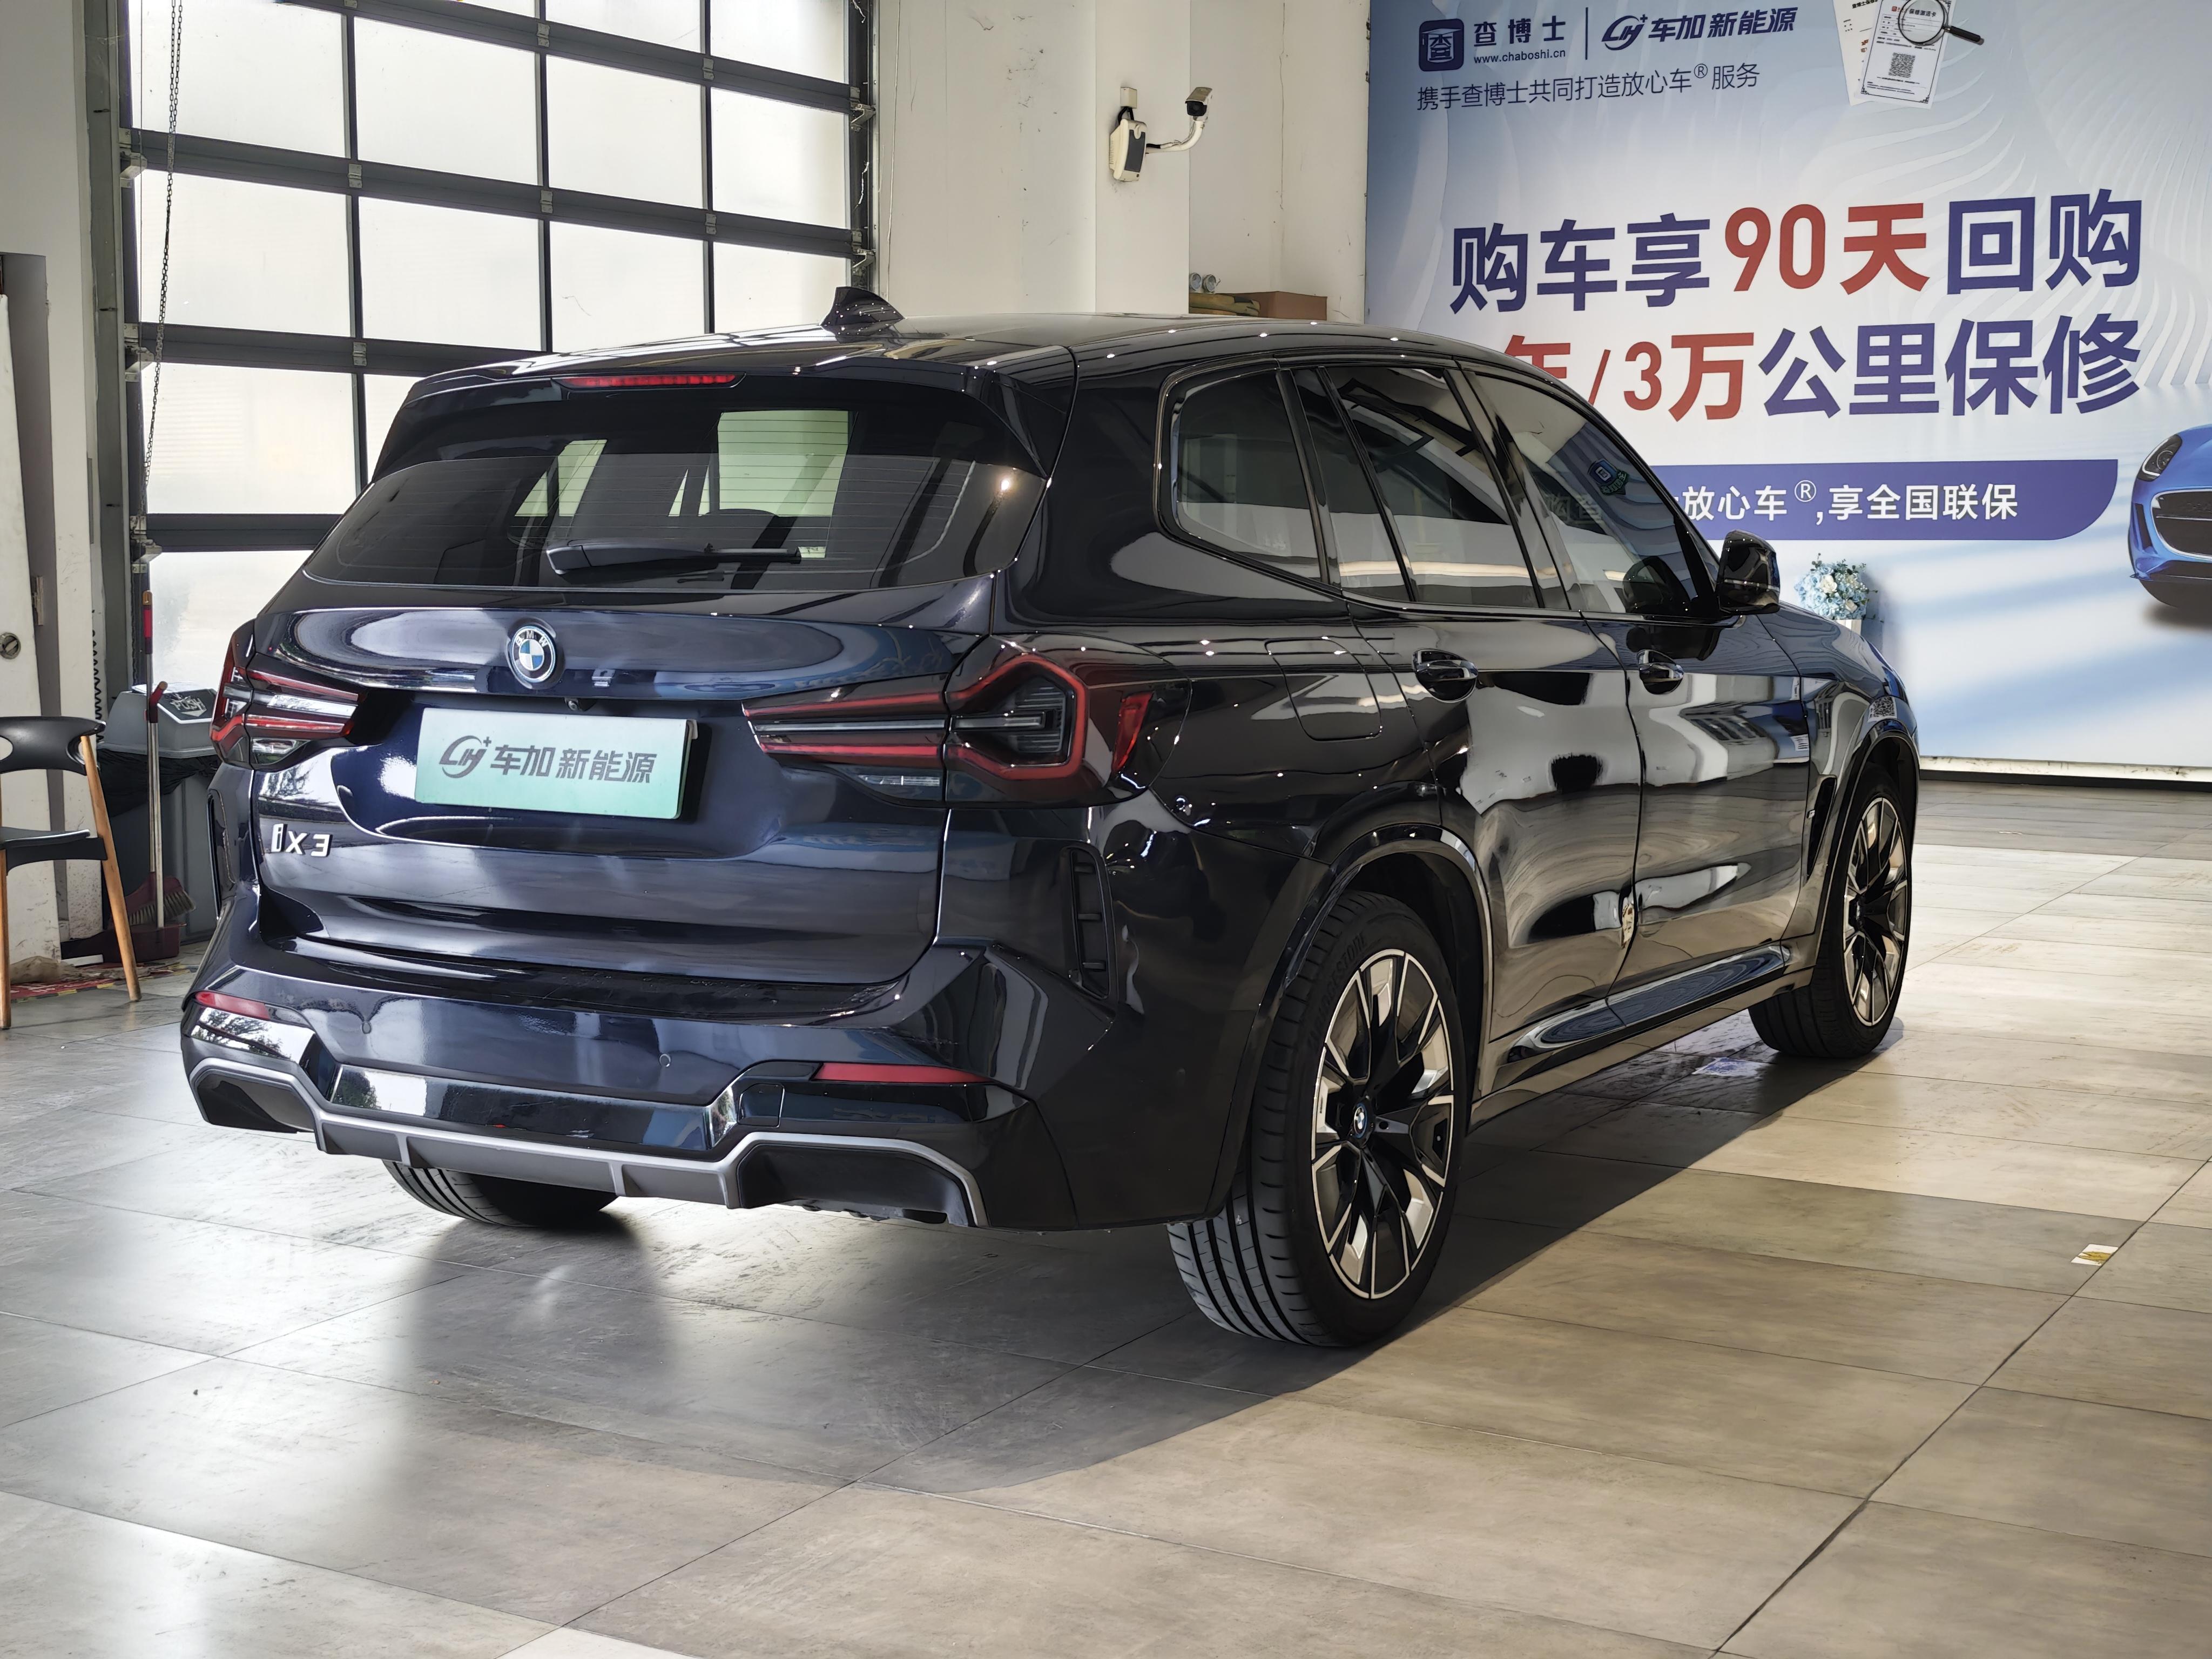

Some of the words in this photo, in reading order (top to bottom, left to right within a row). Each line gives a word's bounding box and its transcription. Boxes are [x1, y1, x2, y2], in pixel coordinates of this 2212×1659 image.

[1473, 15, 1566, 47] 查博士
[1648, 7, 1798, 42] 车加新能源
[1473, 49, 1566, 64] www.chaboshi.cn
[1449, 188, 2142, 314] 购车享90天回购
[1674, 480, 2018, 525] 放心车®,享全国联保
[515, 630, 548, 648] BMW
[170, 696, 206, 711] PUSH
[490, 744, 657, 783] 车加新能源
